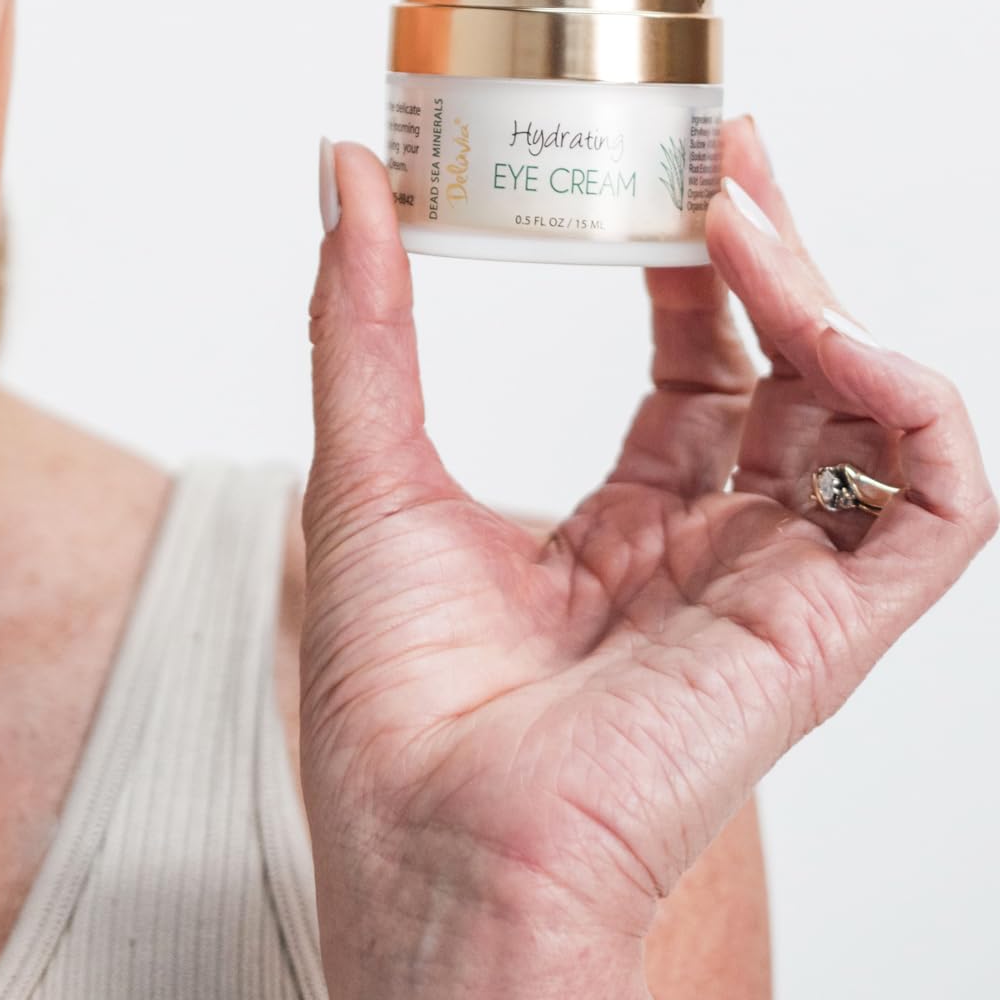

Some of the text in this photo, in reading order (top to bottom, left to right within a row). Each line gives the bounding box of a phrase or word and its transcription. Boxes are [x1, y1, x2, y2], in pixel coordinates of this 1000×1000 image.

[429, 98, 444, 220] DEAD SEA MINERALS
[509, 119, 625, 163] Hydrating
[493, 163, 637, 198] EYE CREAM
[515, 214, 531, 226] 0.5
[534, 216, 546, 227] FL
[549, 217, 565, 228] OZ
[576, 219, 587, 229] 15
